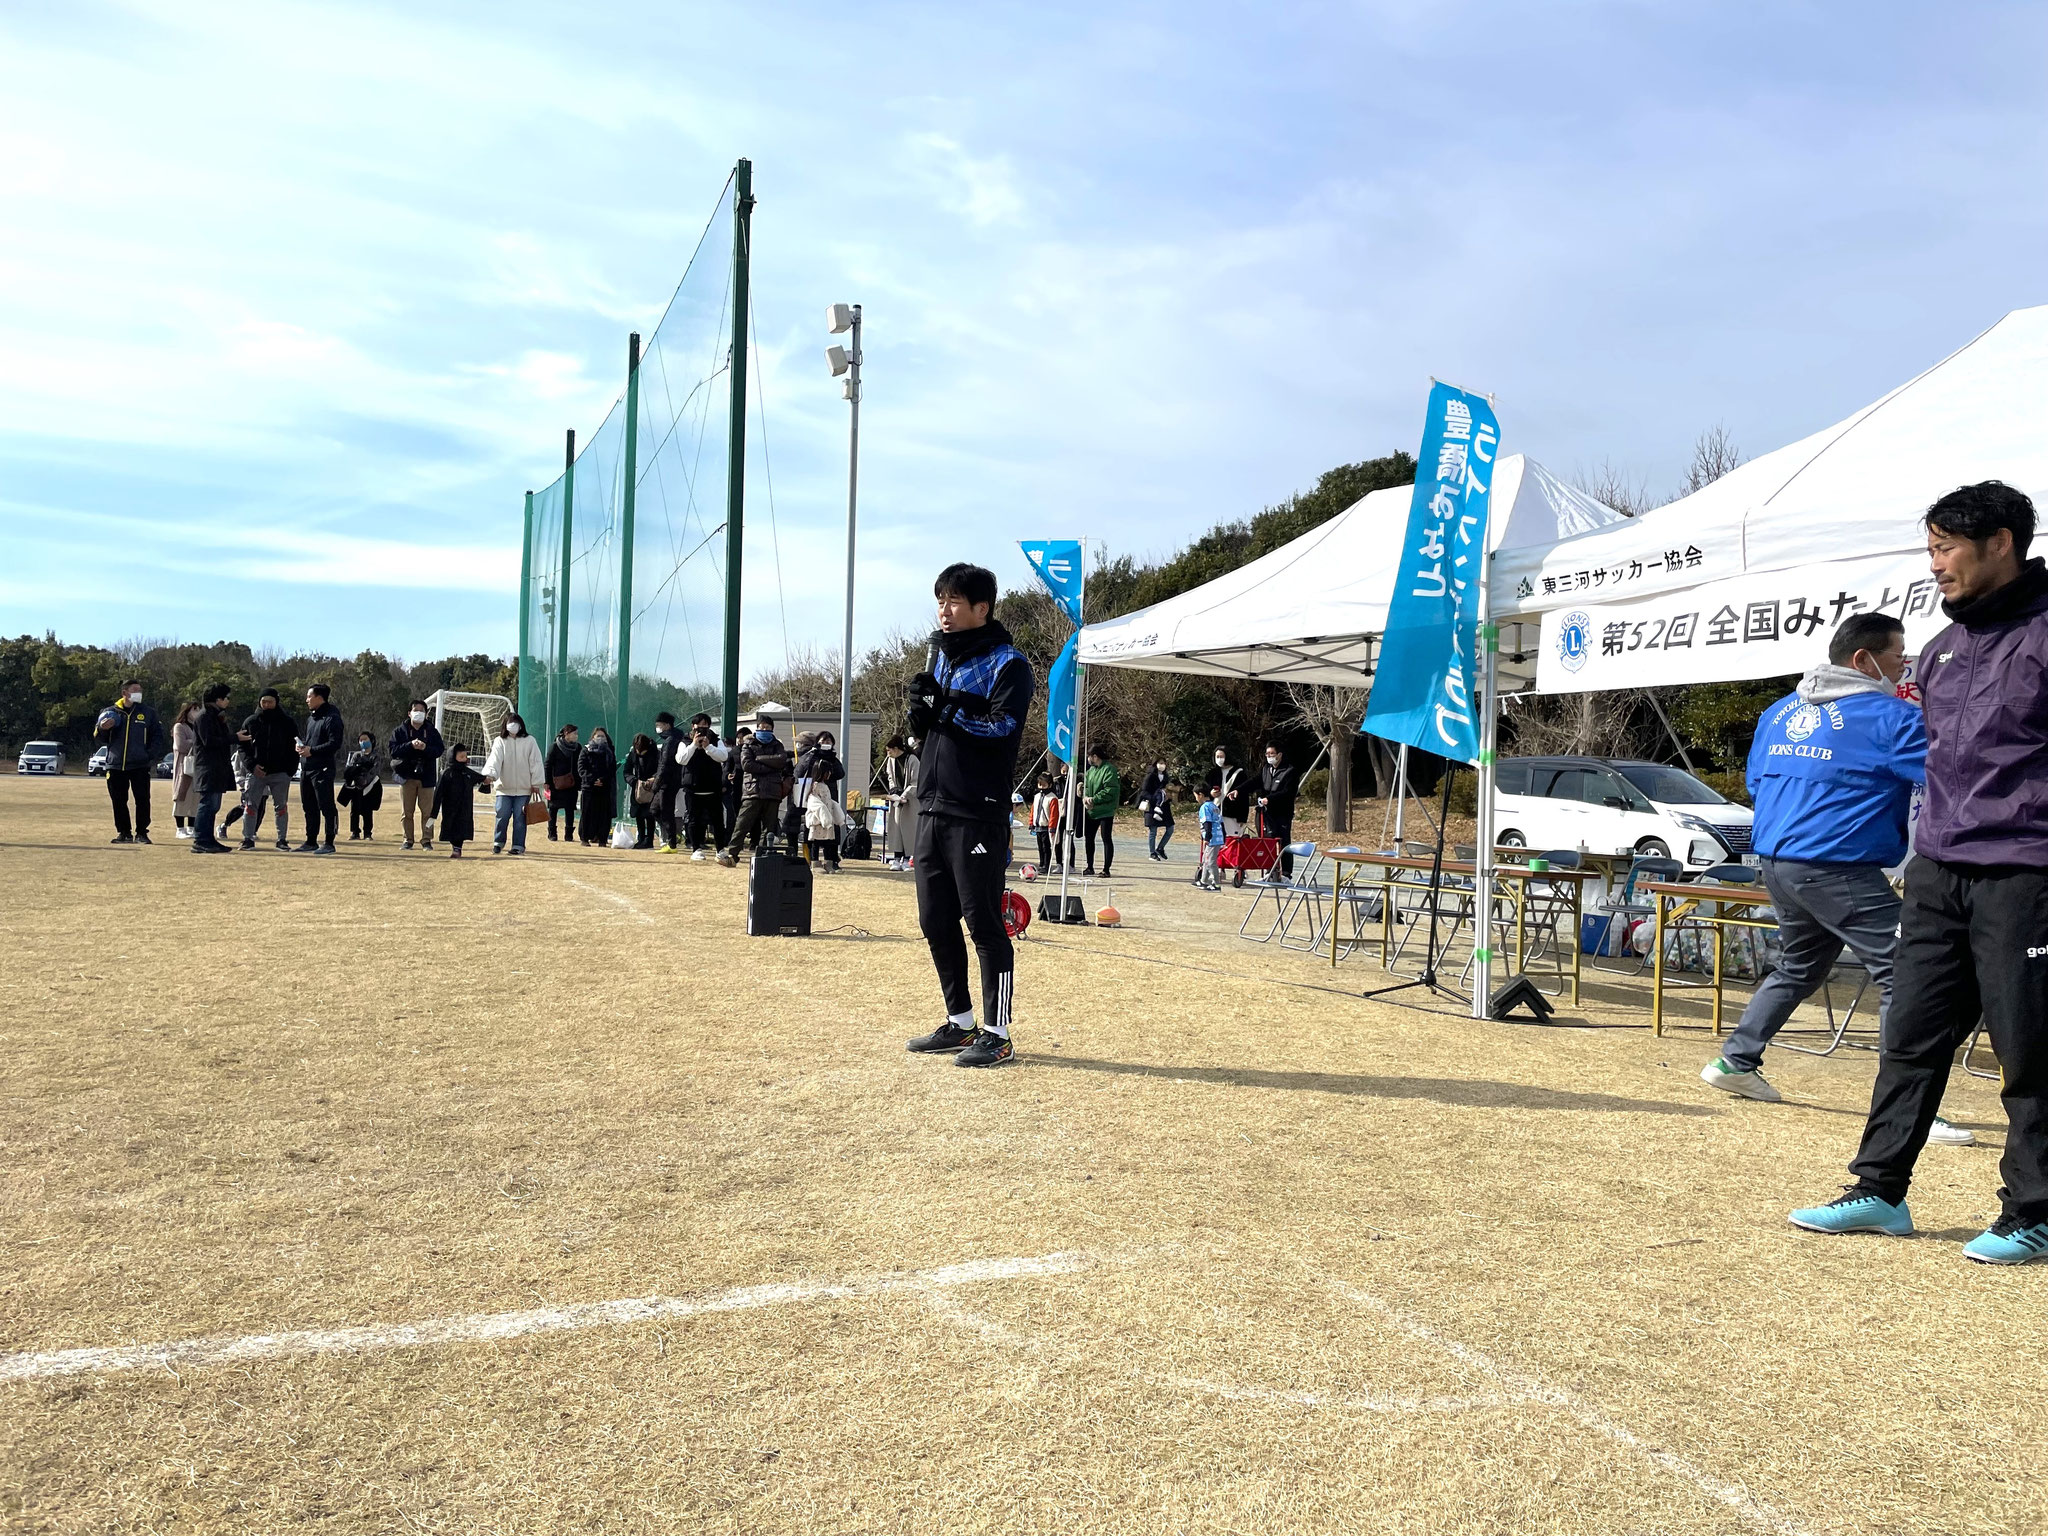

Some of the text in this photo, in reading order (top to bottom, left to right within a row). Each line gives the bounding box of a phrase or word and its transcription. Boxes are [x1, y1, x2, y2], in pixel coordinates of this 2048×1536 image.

[1541, 545, 1704, 596] 東三河サッカー協会
[1601, 612, 1700, 657] 第52回
[1794, 745, 1833, 761] CLUB
